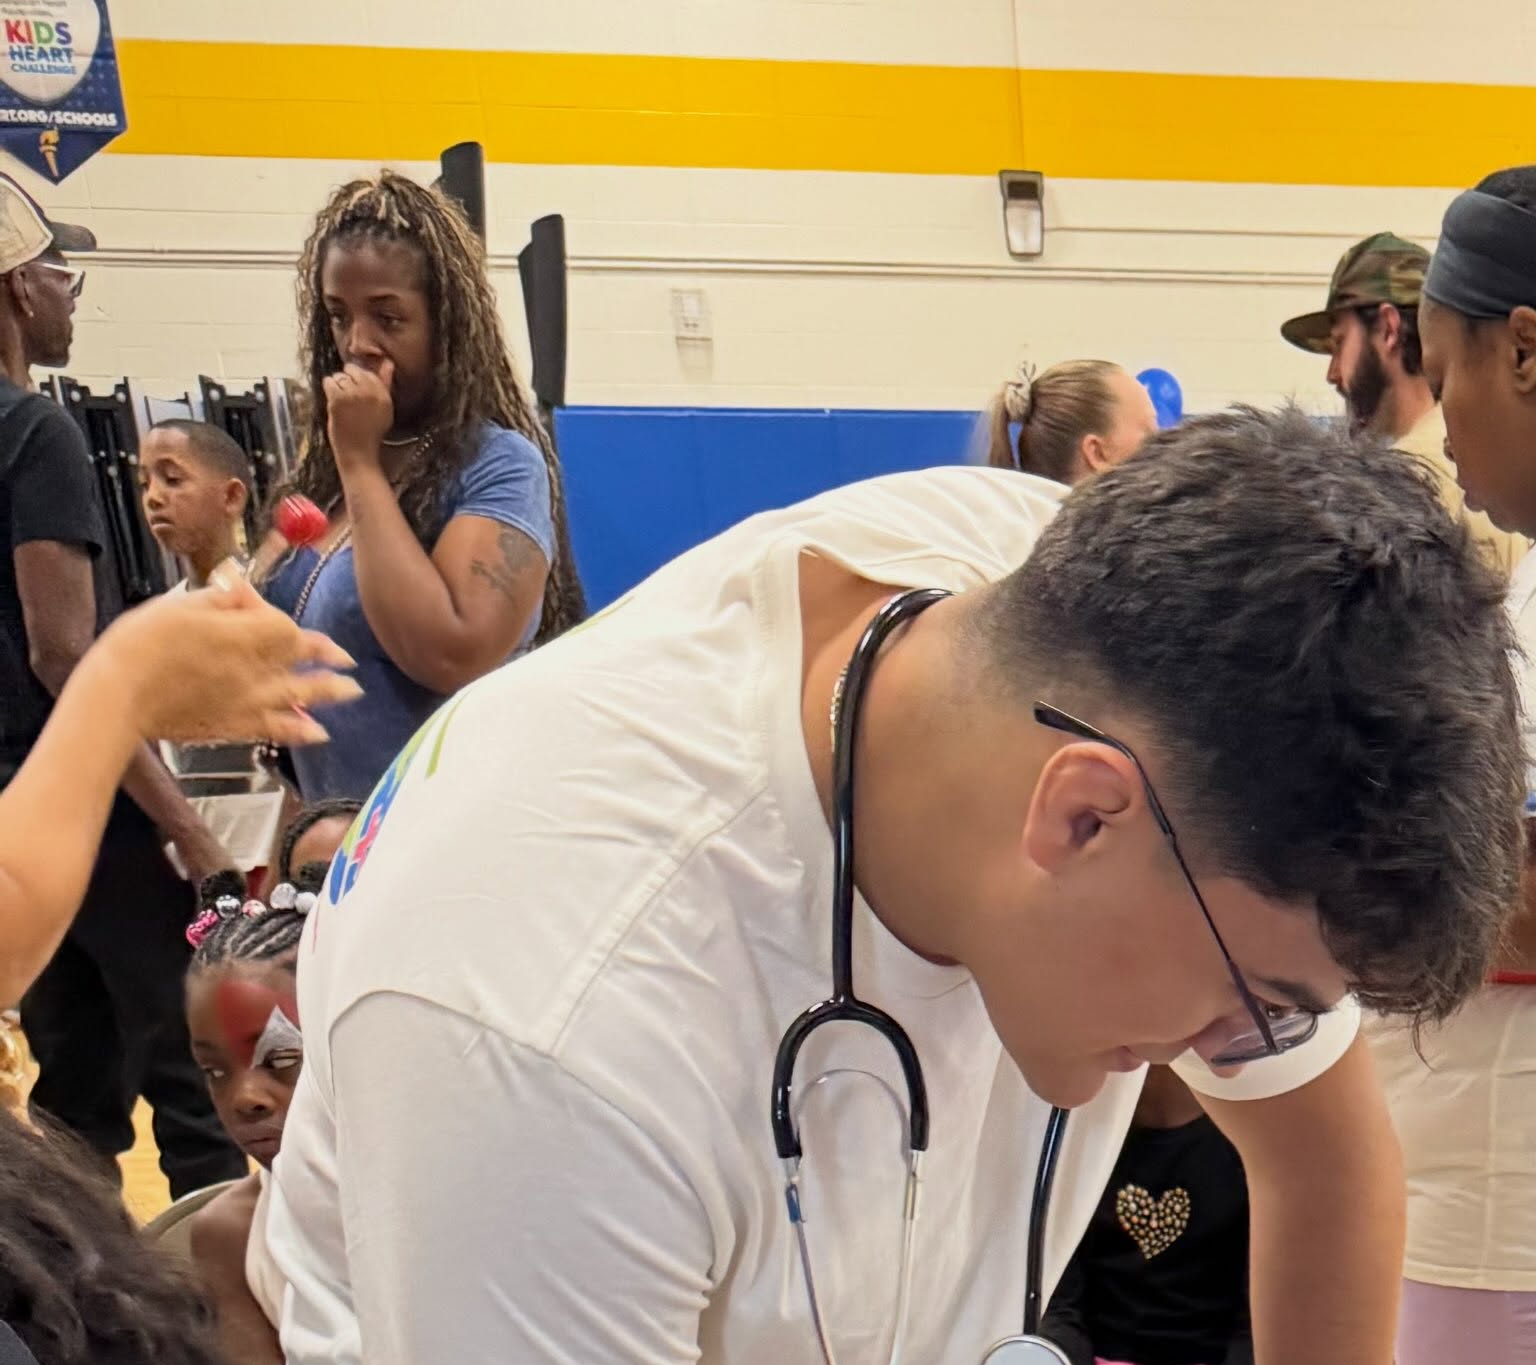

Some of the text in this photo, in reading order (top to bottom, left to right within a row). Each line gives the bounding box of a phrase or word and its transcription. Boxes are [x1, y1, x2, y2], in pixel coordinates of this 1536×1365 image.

[5, 19, 72, 45] KIDS
[9, 46, 73, 62] HEART
[11, 63, 76, 75] CHALLENGE
